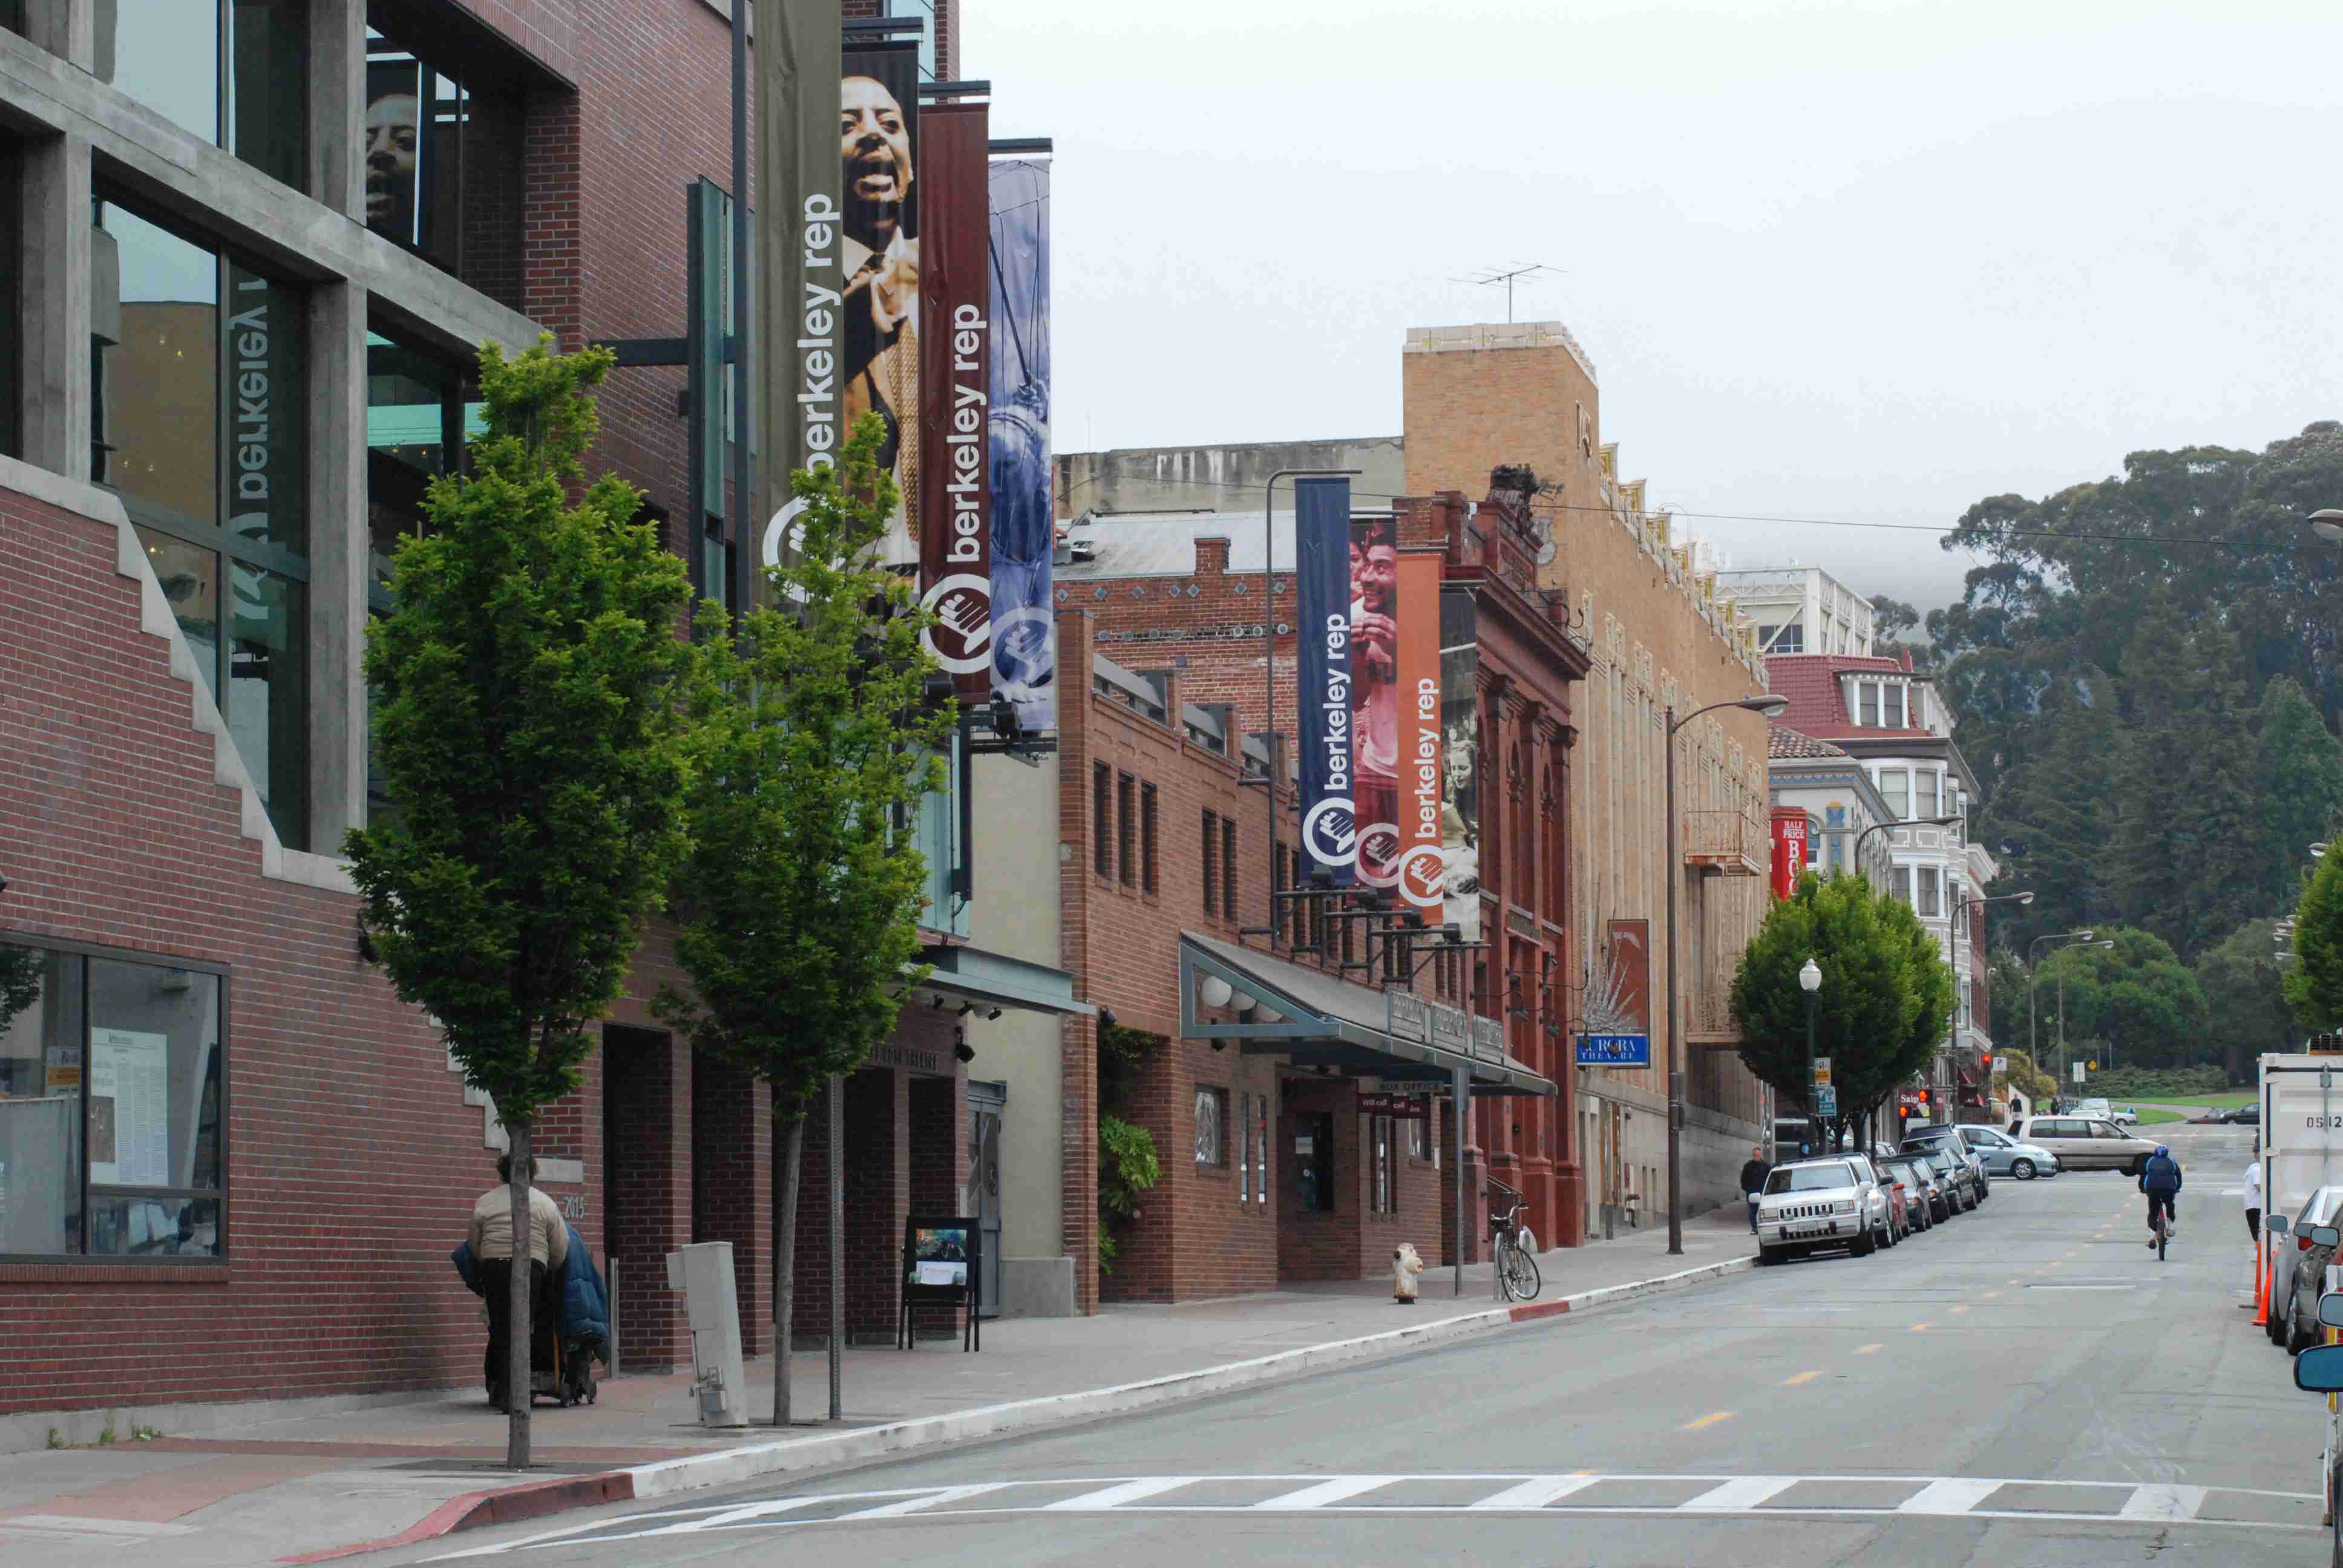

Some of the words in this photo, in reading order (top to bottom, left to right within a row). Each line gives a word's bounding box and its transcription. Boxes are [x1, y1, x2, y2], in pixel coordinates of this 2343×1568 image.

[804, 194, 841, 267] rep
[954, 304, 987, 370] rep
[946, 384, 987, 562] berkeley
[1326, 613, 1350, 659] rep
[1323, 668, 1351, 790] berkeley
[1418, 678, 1439, 720] rep
[1414, 727, 1439, 838] berkeley
[1783, 830, 1804, 839] PRICE
[1788, 840, 1800, 896] BOO
